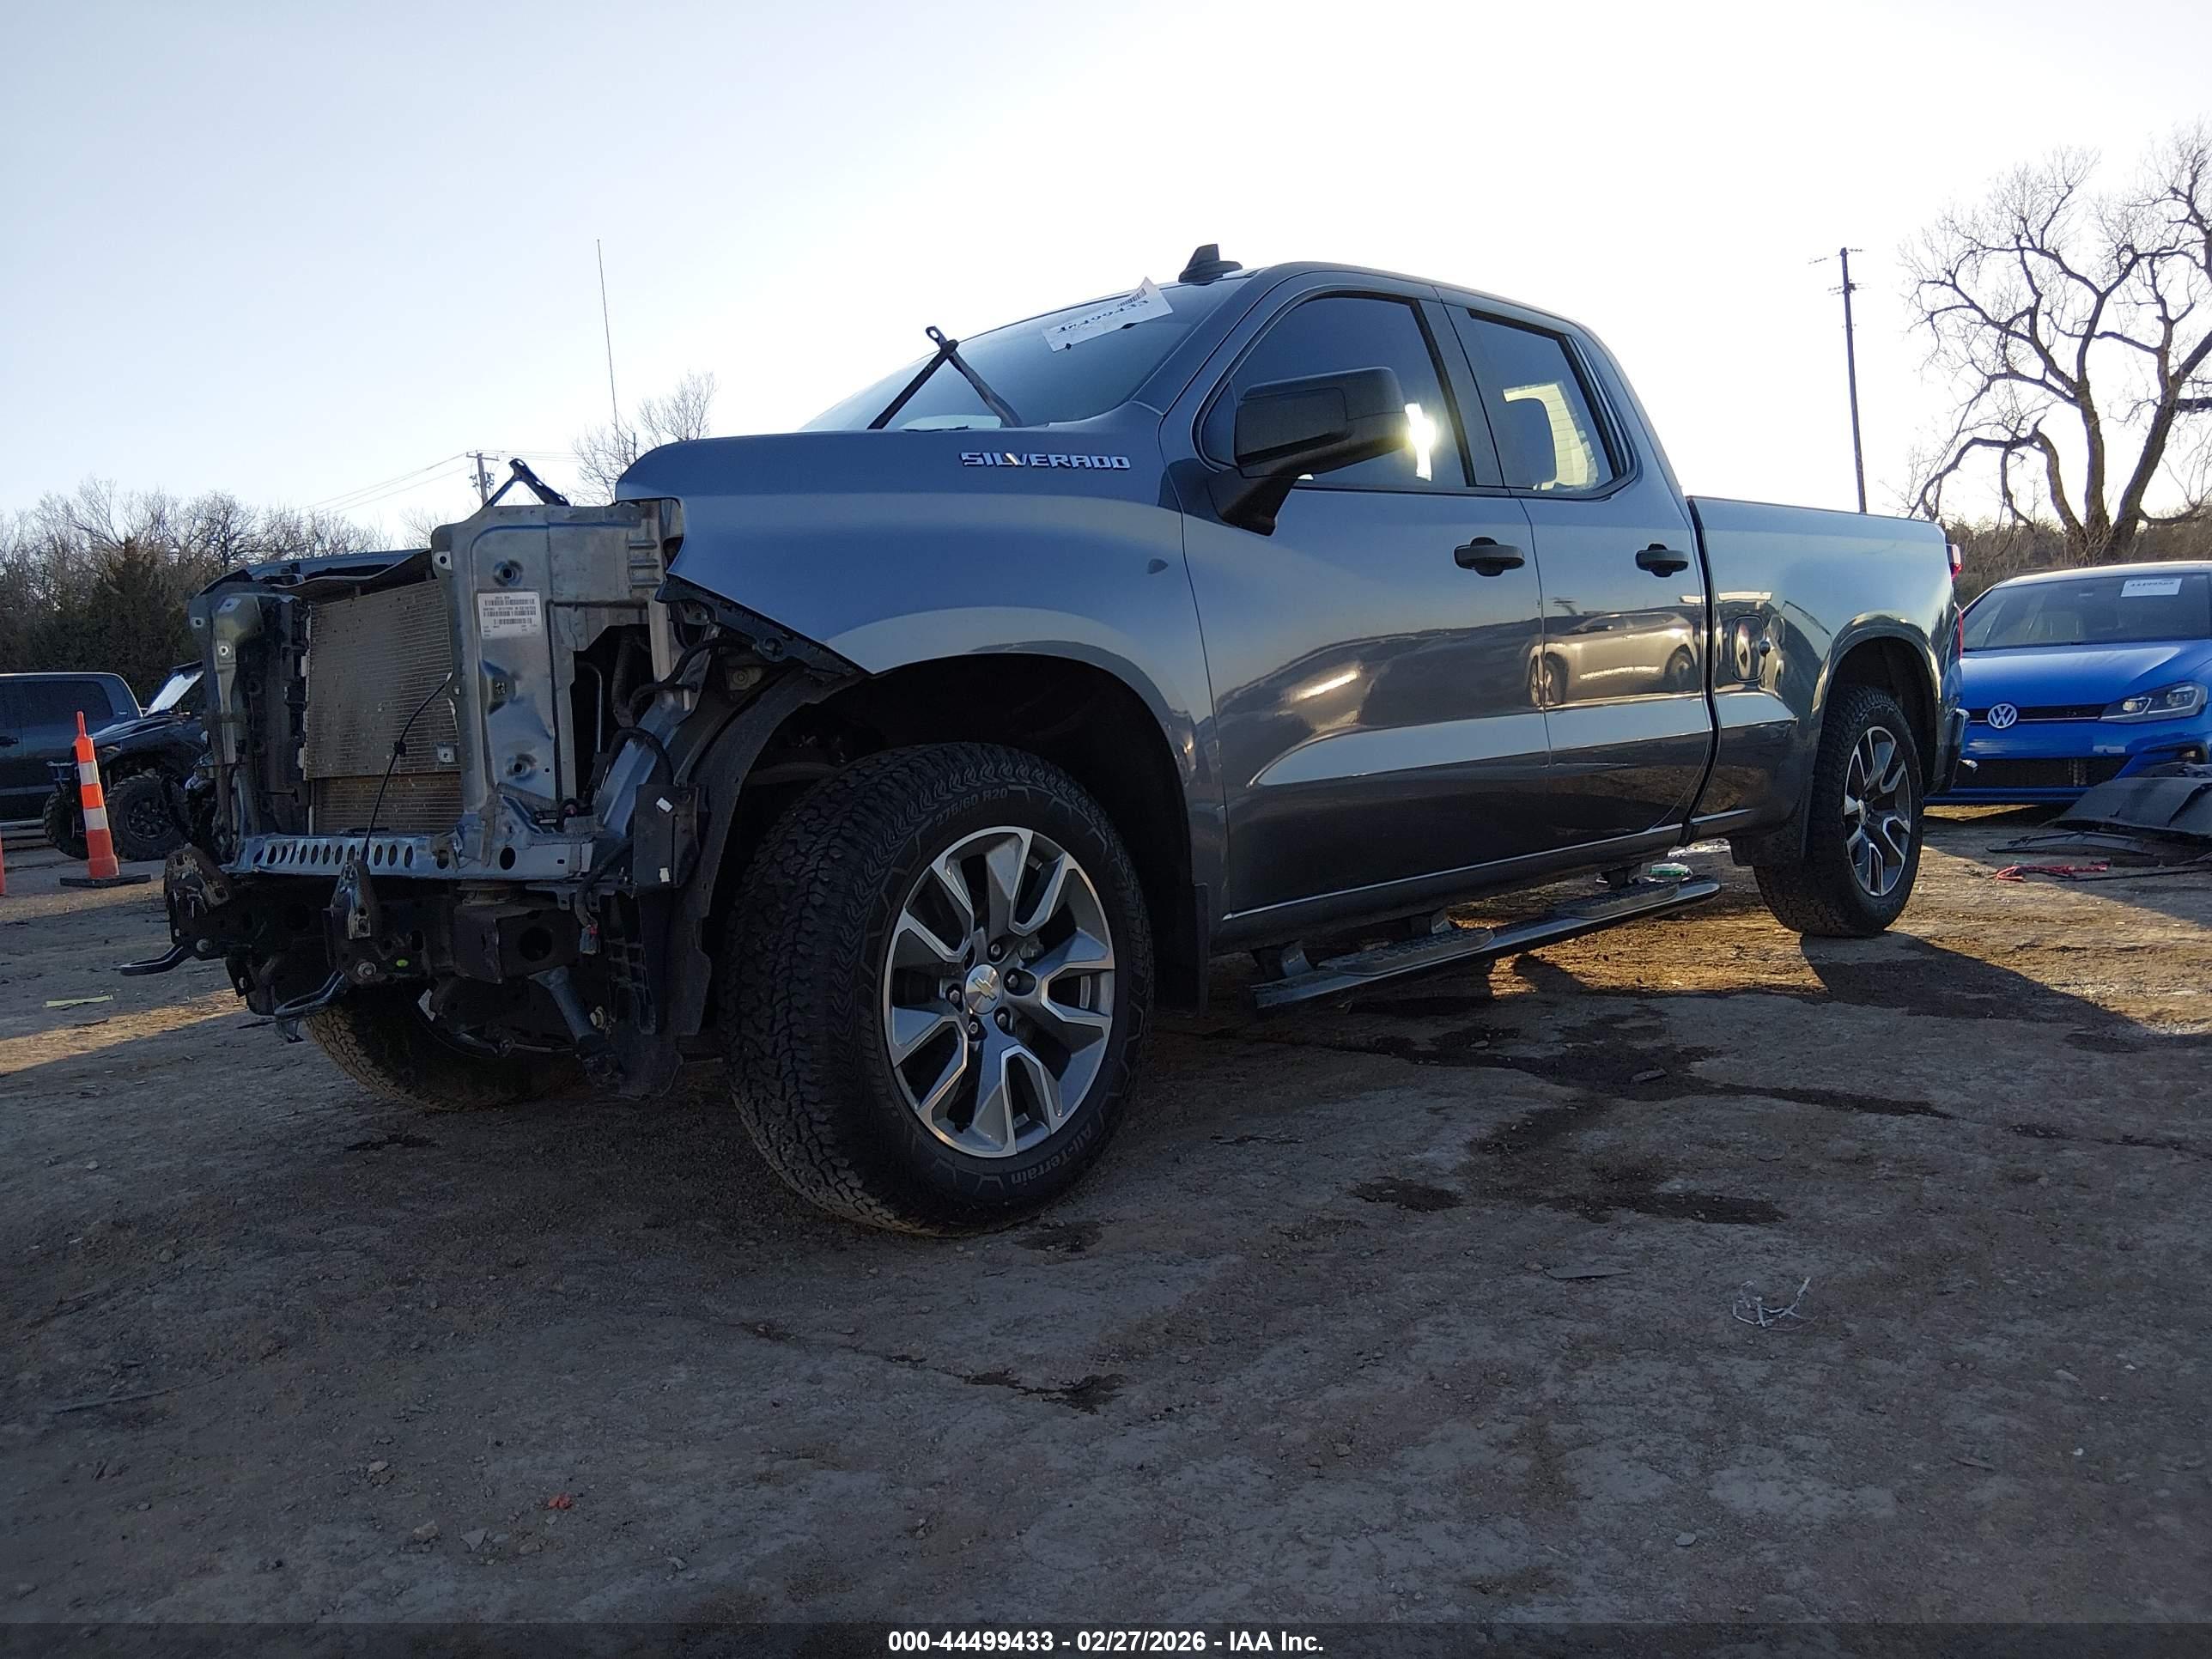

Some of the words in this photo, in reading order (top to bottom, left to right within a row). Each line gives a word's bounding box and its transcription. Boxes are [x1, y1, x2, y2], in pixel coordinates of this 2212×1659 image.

[959, 451, 1132, 470] SILVERADO
[934, 793, 980, 827] 275/60
[981, 787, 1009, 802] R20
[1010, 1121, 1092, 1188] All-Terrain
